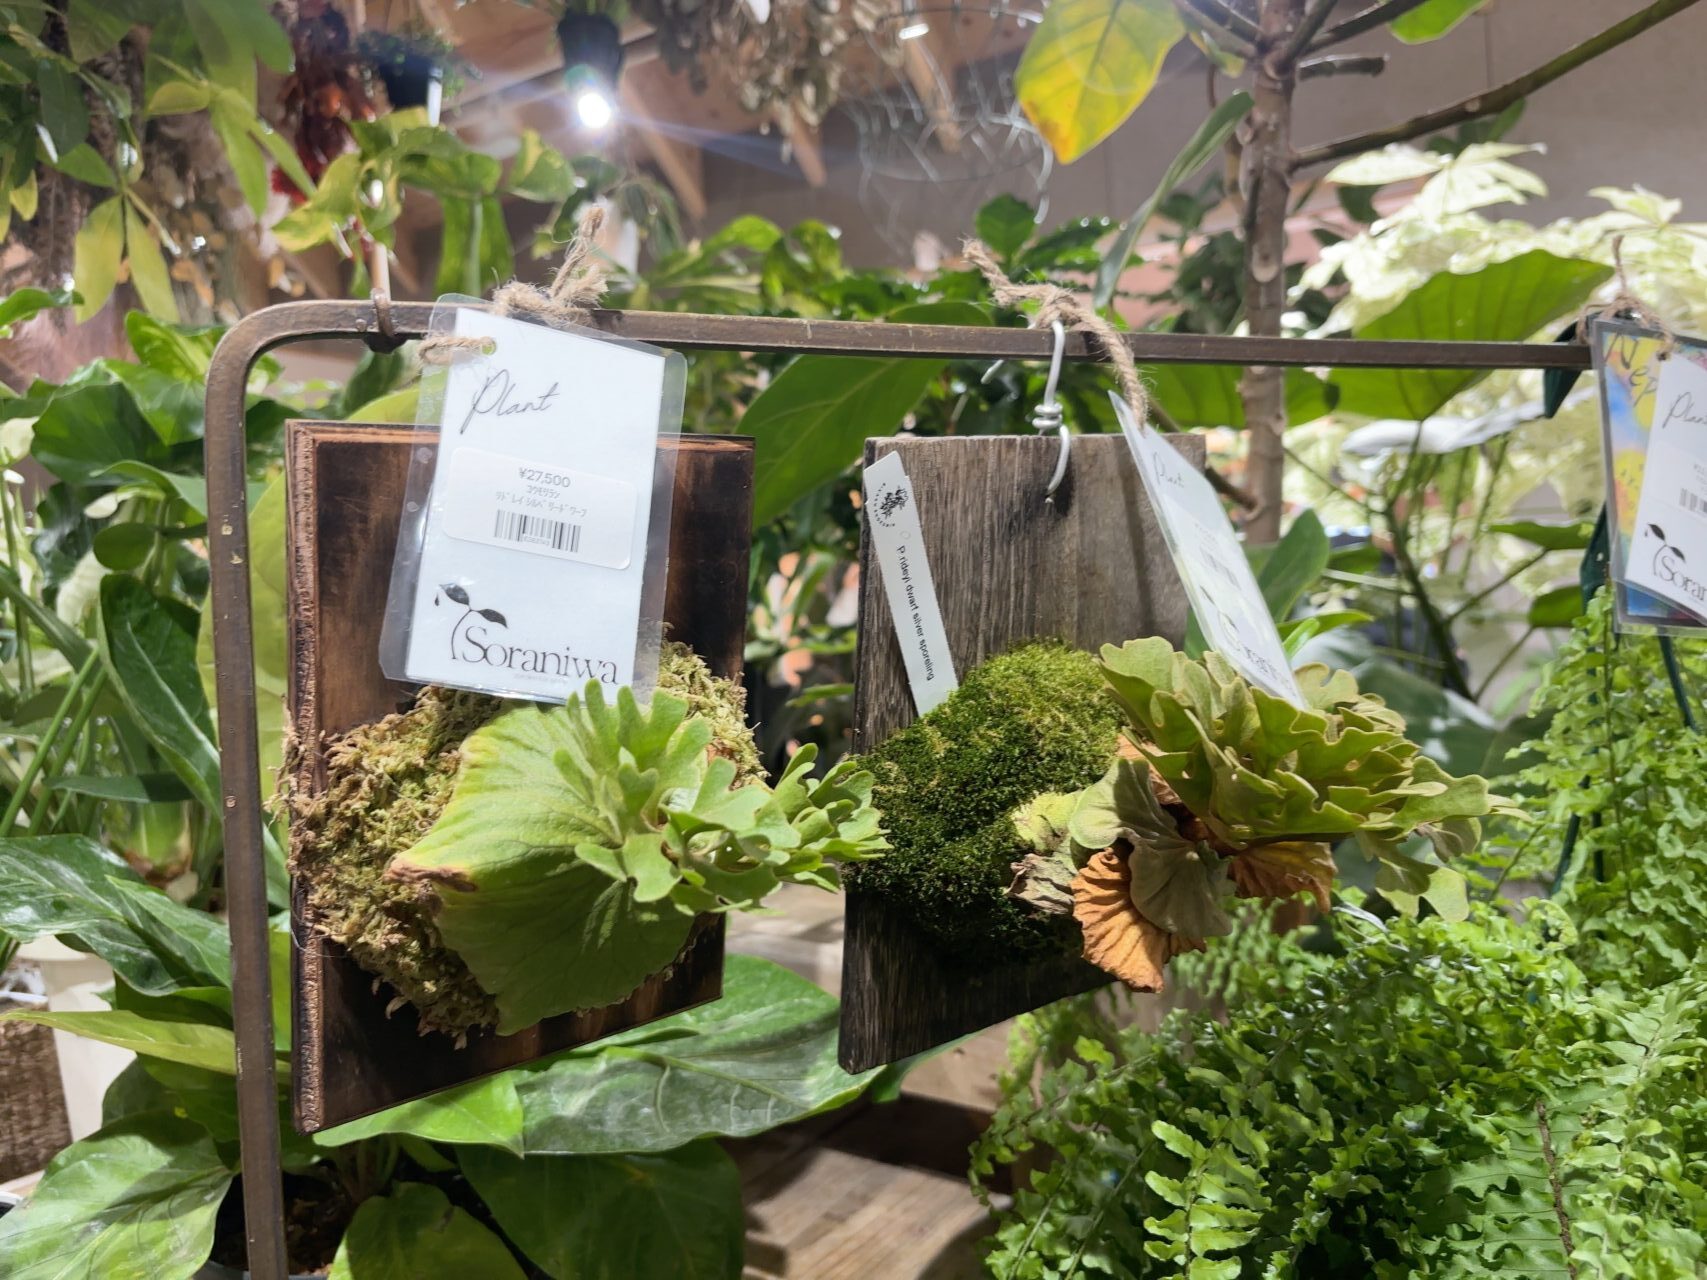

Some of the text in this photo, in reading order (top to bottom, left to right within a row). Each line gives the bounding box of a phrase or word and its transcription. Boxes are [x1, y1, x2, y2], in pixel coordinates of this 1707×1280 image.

[460, 368, 560, 435] Plant
[518, 466, 572, 489] ¥27,500
[462, 625, 619, 685] Soraniwa
